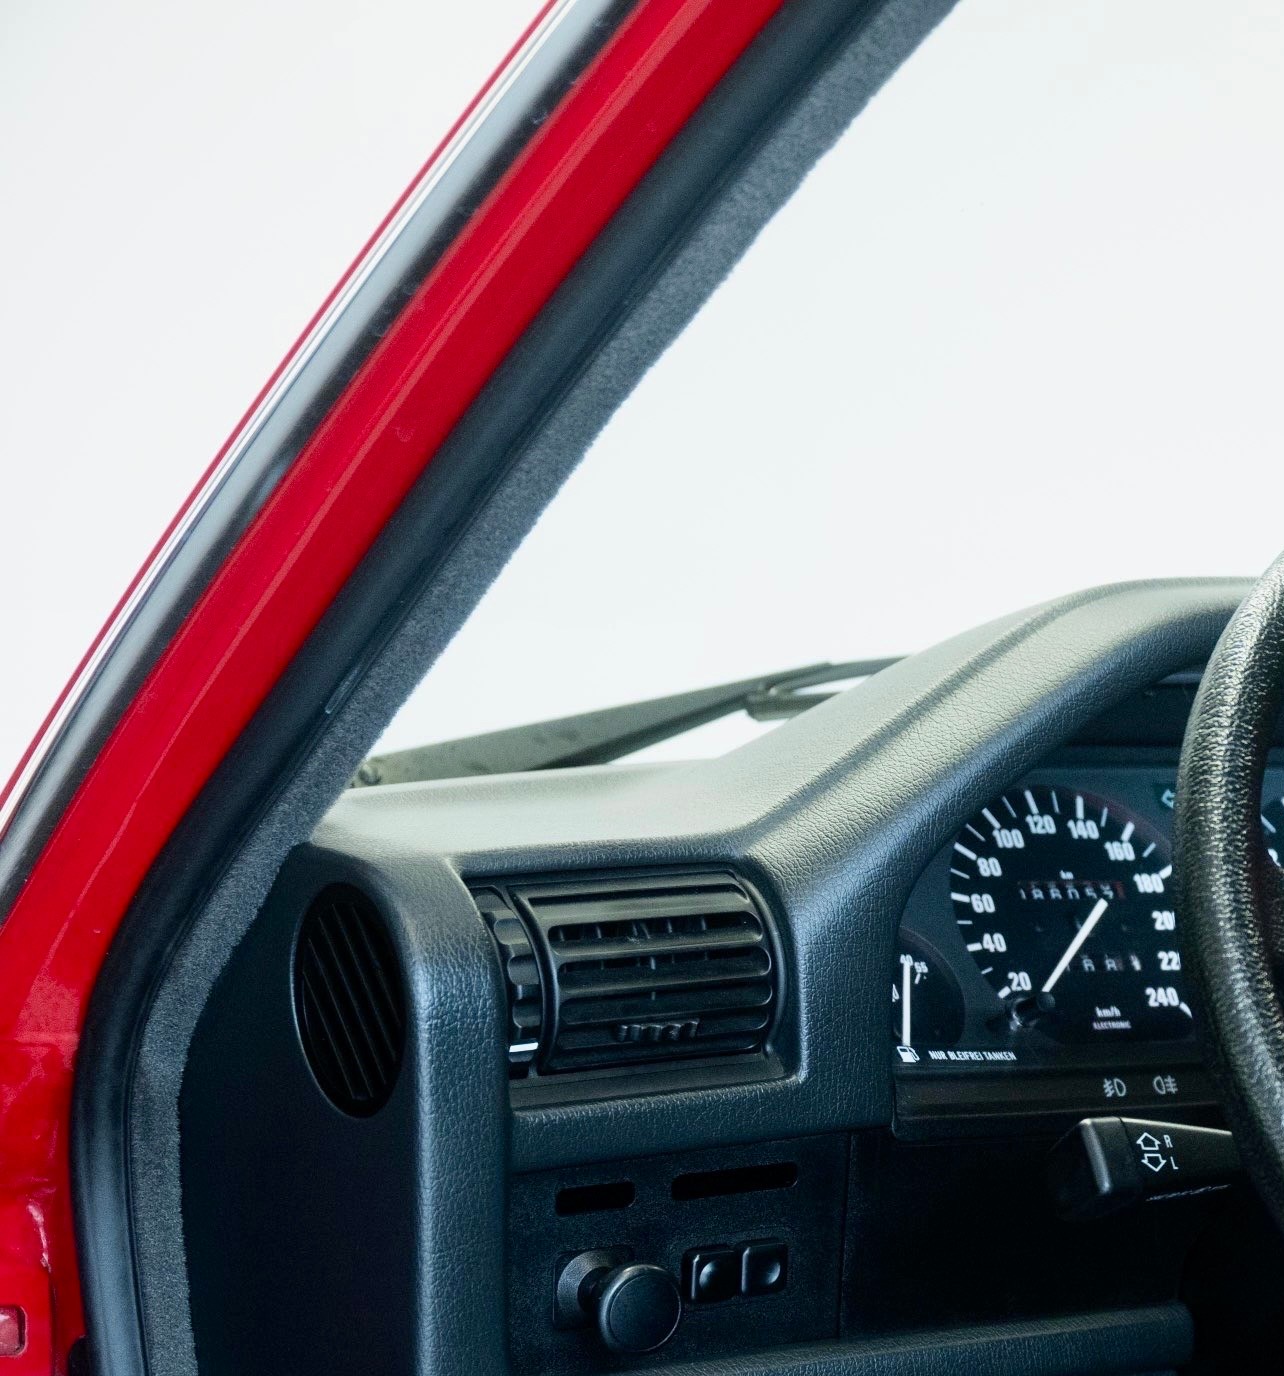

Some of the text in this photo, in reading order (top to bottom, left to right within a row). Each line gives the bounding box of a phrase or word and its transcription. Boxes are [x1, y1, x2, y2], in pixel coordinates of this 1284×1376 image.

[1025, 814, 1057, 835] 120
[1067, 820, 1099, 840] 140
[992, 828, 1025, 849] 100
[1104, 841, 1136, 862] 160
[976, 857, 1003, 877] 80
[1133, 872, 1165, 894] 180
[970, 894, 996, 914] 60
[1151, 910, 1176, 932] 20
[982, 932, 1007, 953] 40
[1157, 950, 1182, 972] 22
[1007, 971, 1032, 991] 20
[1145, 986, 1180, 1008] 240
[1095, 1005, 1122, 1018] km/h
[928, 1050, 1018, 1061] NUR BLEIFREI TANKEN
[1163, 1134, 1174, 1149] R
[1169, 1156, 1180, 1170] L
